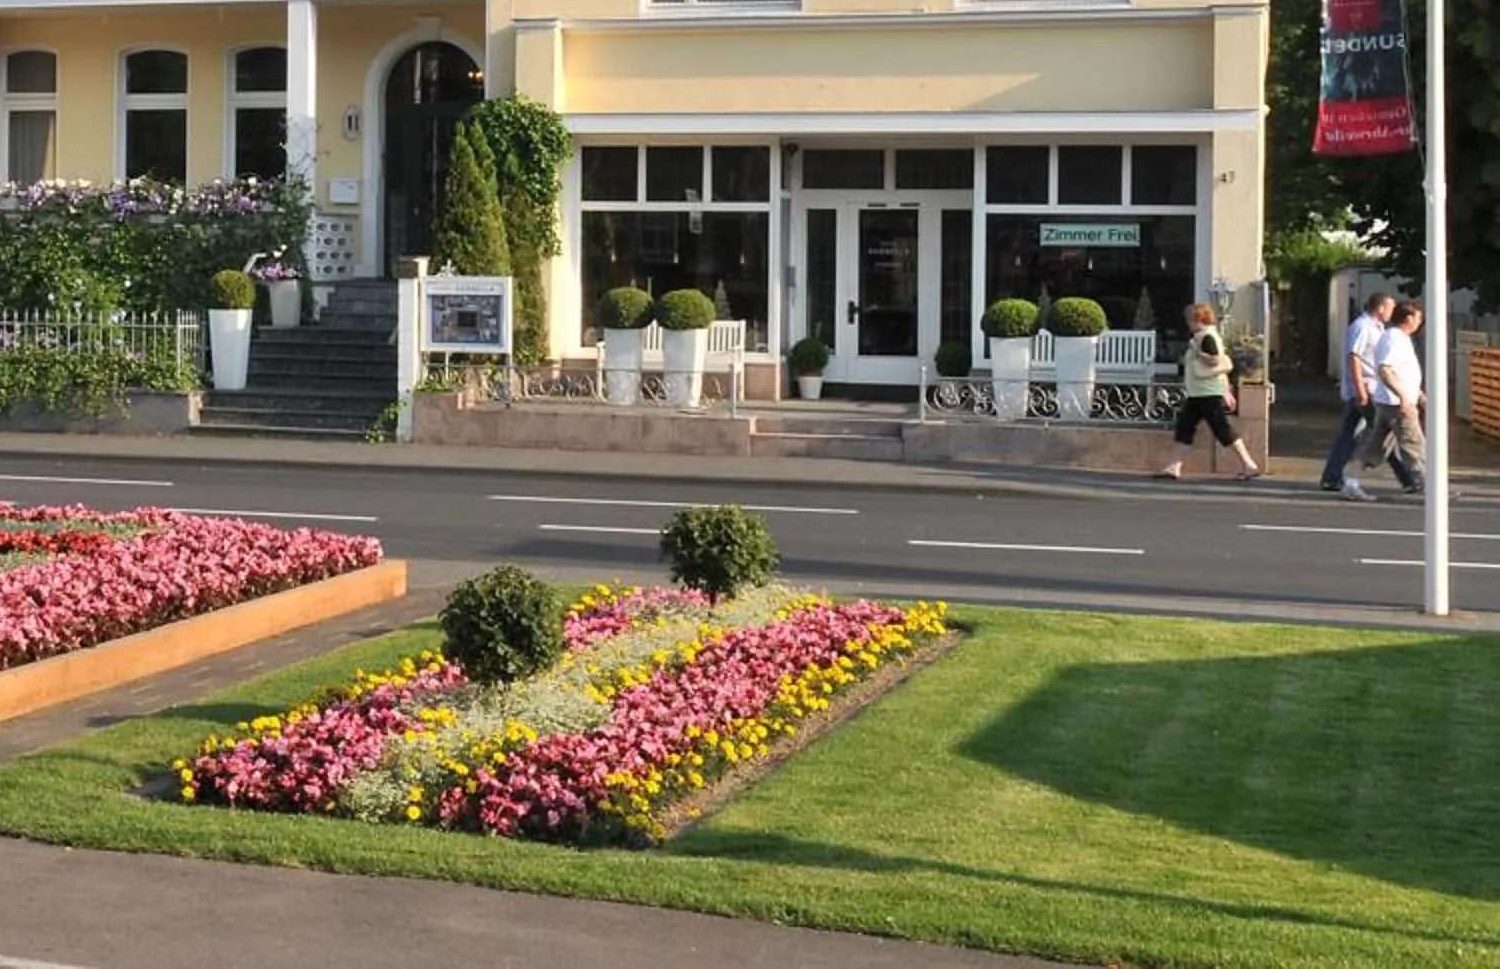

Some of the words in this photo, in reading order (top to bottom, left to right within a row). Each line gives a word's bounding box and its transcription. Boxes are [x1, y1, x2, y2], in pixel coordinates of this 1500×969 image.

[1221, 171, 1236, 184] 47
[1043, 228, 1102, 241] Zimmer
[1108, 227, 1138, 241] Frei
